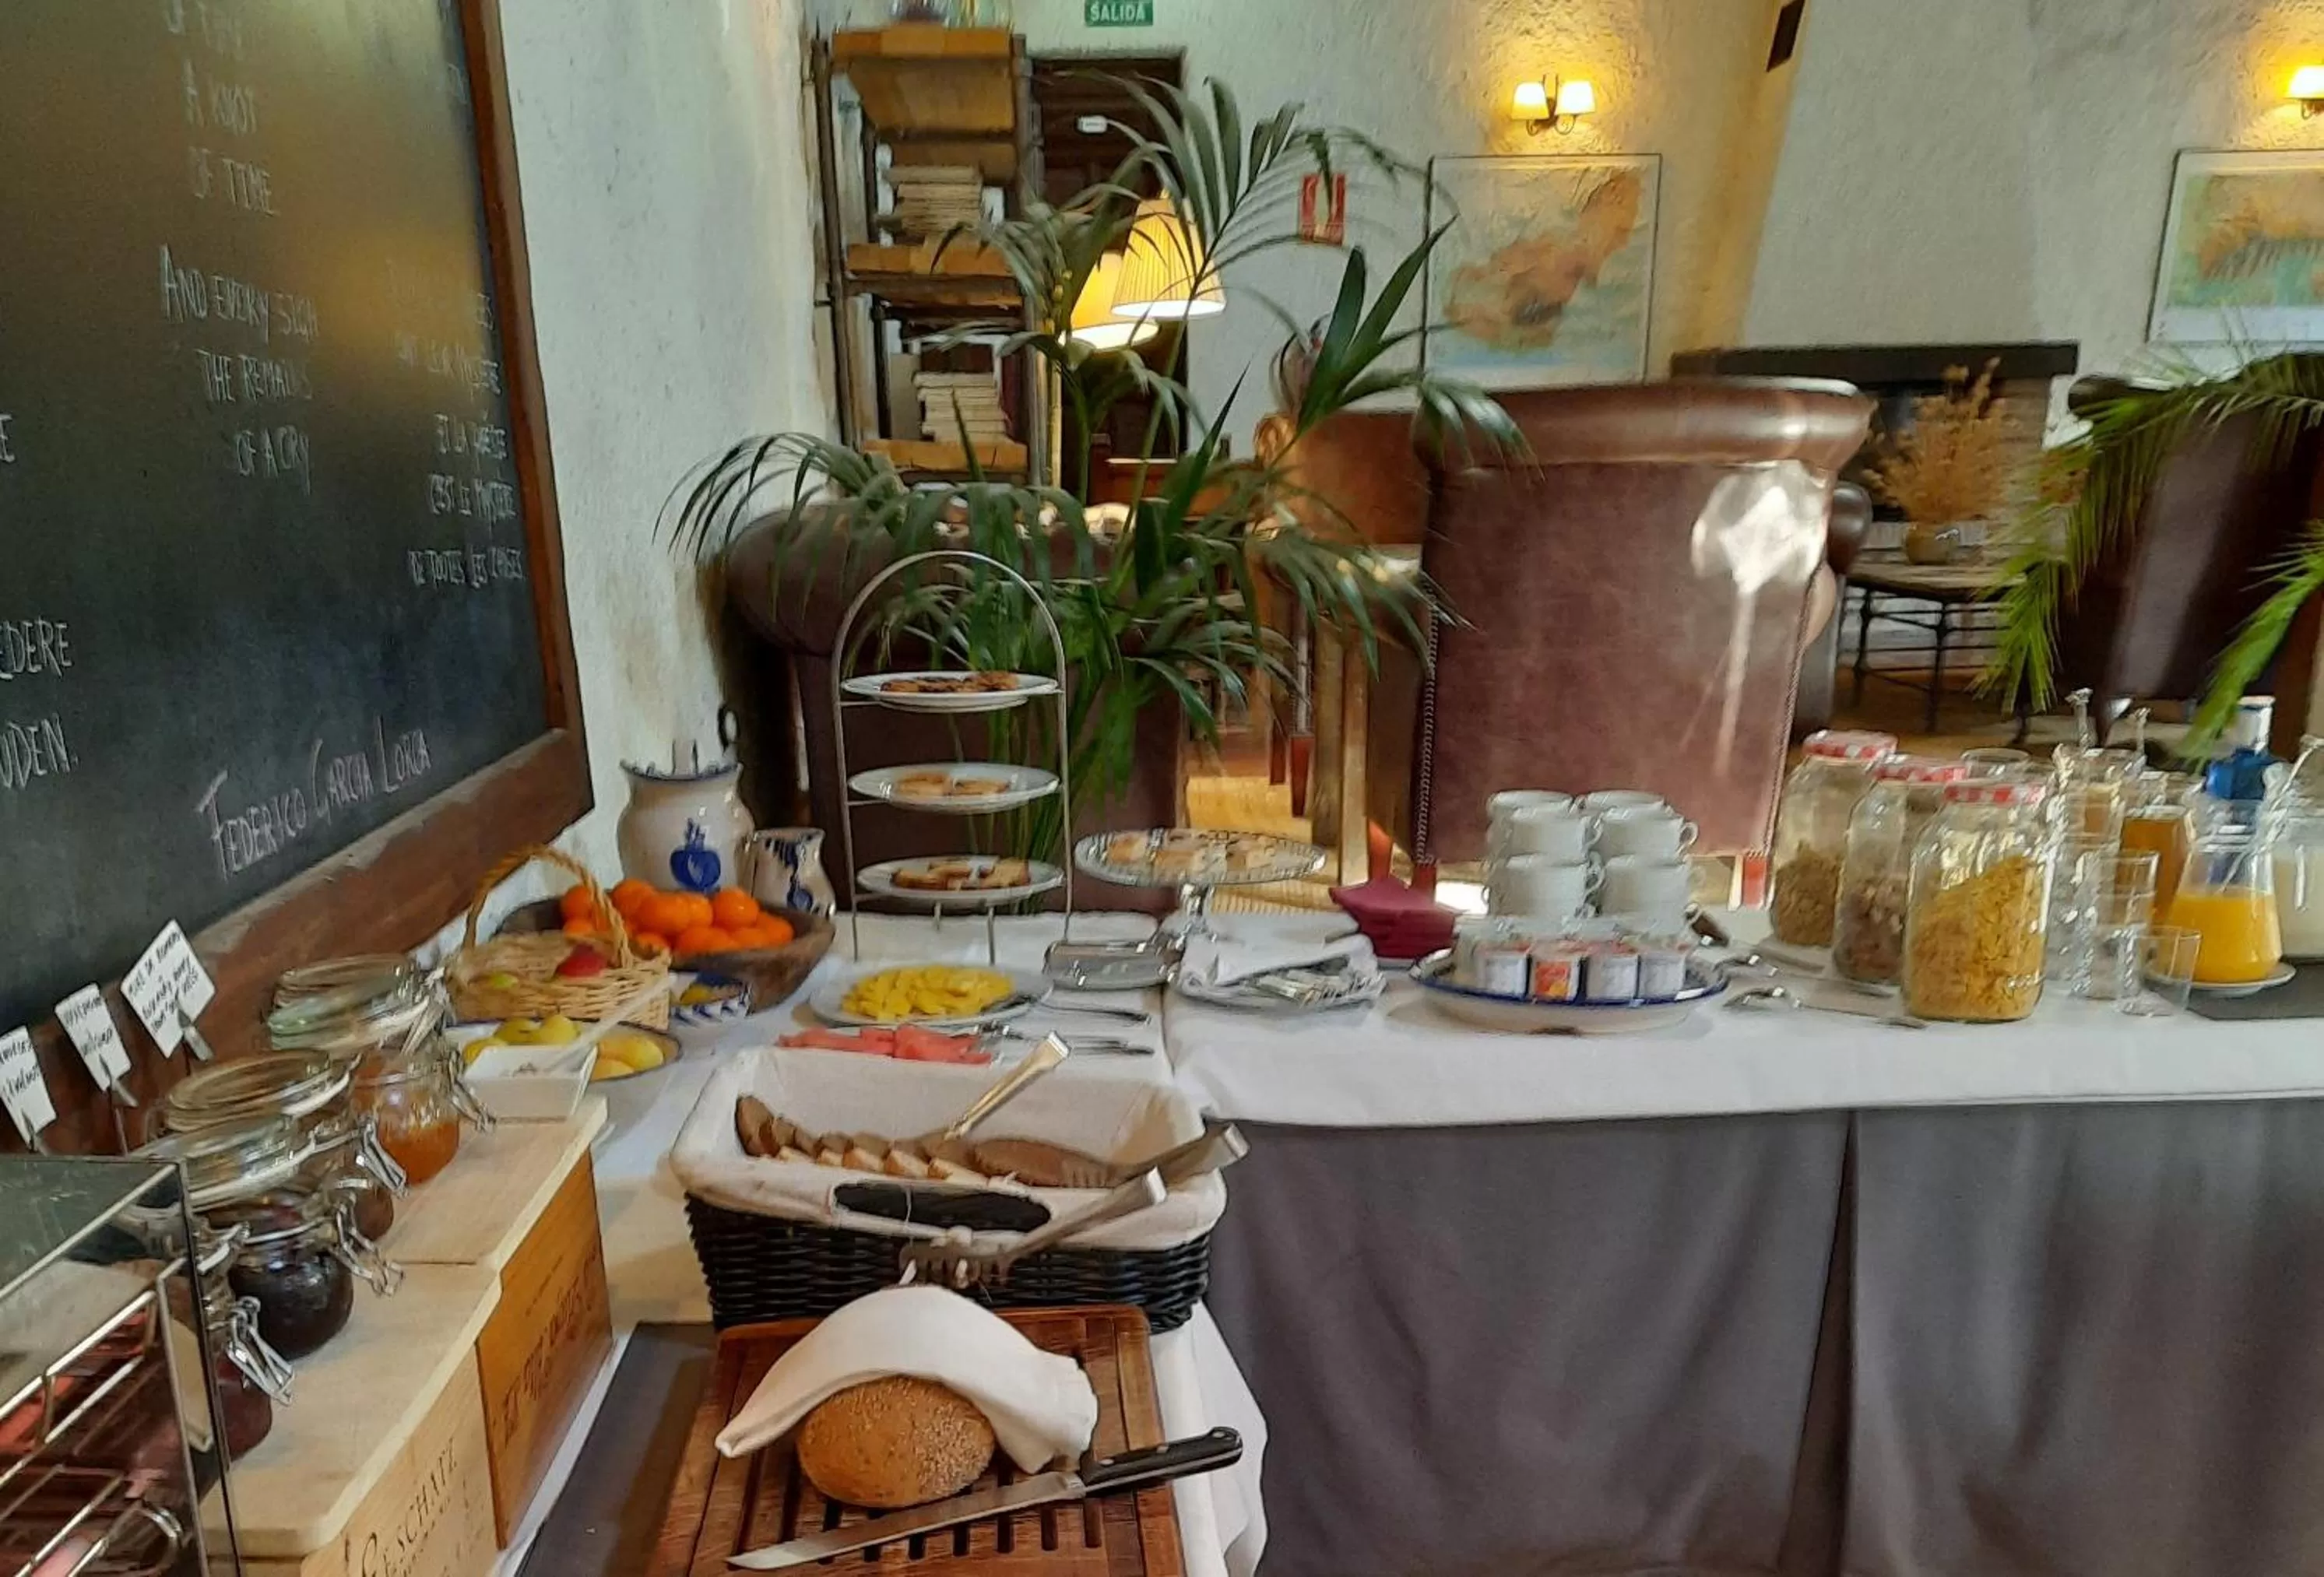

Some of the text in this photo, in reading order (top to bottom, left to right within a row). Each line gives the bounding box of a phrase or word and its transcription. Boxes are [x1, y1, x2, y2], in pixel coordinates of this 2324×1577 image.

[1090, 2, 1146, 23] SALIDA
[221, 158, 281, 217] TIME
[159, 242, 208, 324] AND
[209, 274, 269, 345] EVERY
[194, 349, 237, 403] THE
[234, 424, 311, 498] OF A CRY
[195, 769, 308, 884] FEDERICO
[376, 714, 431, 794] LORCA
